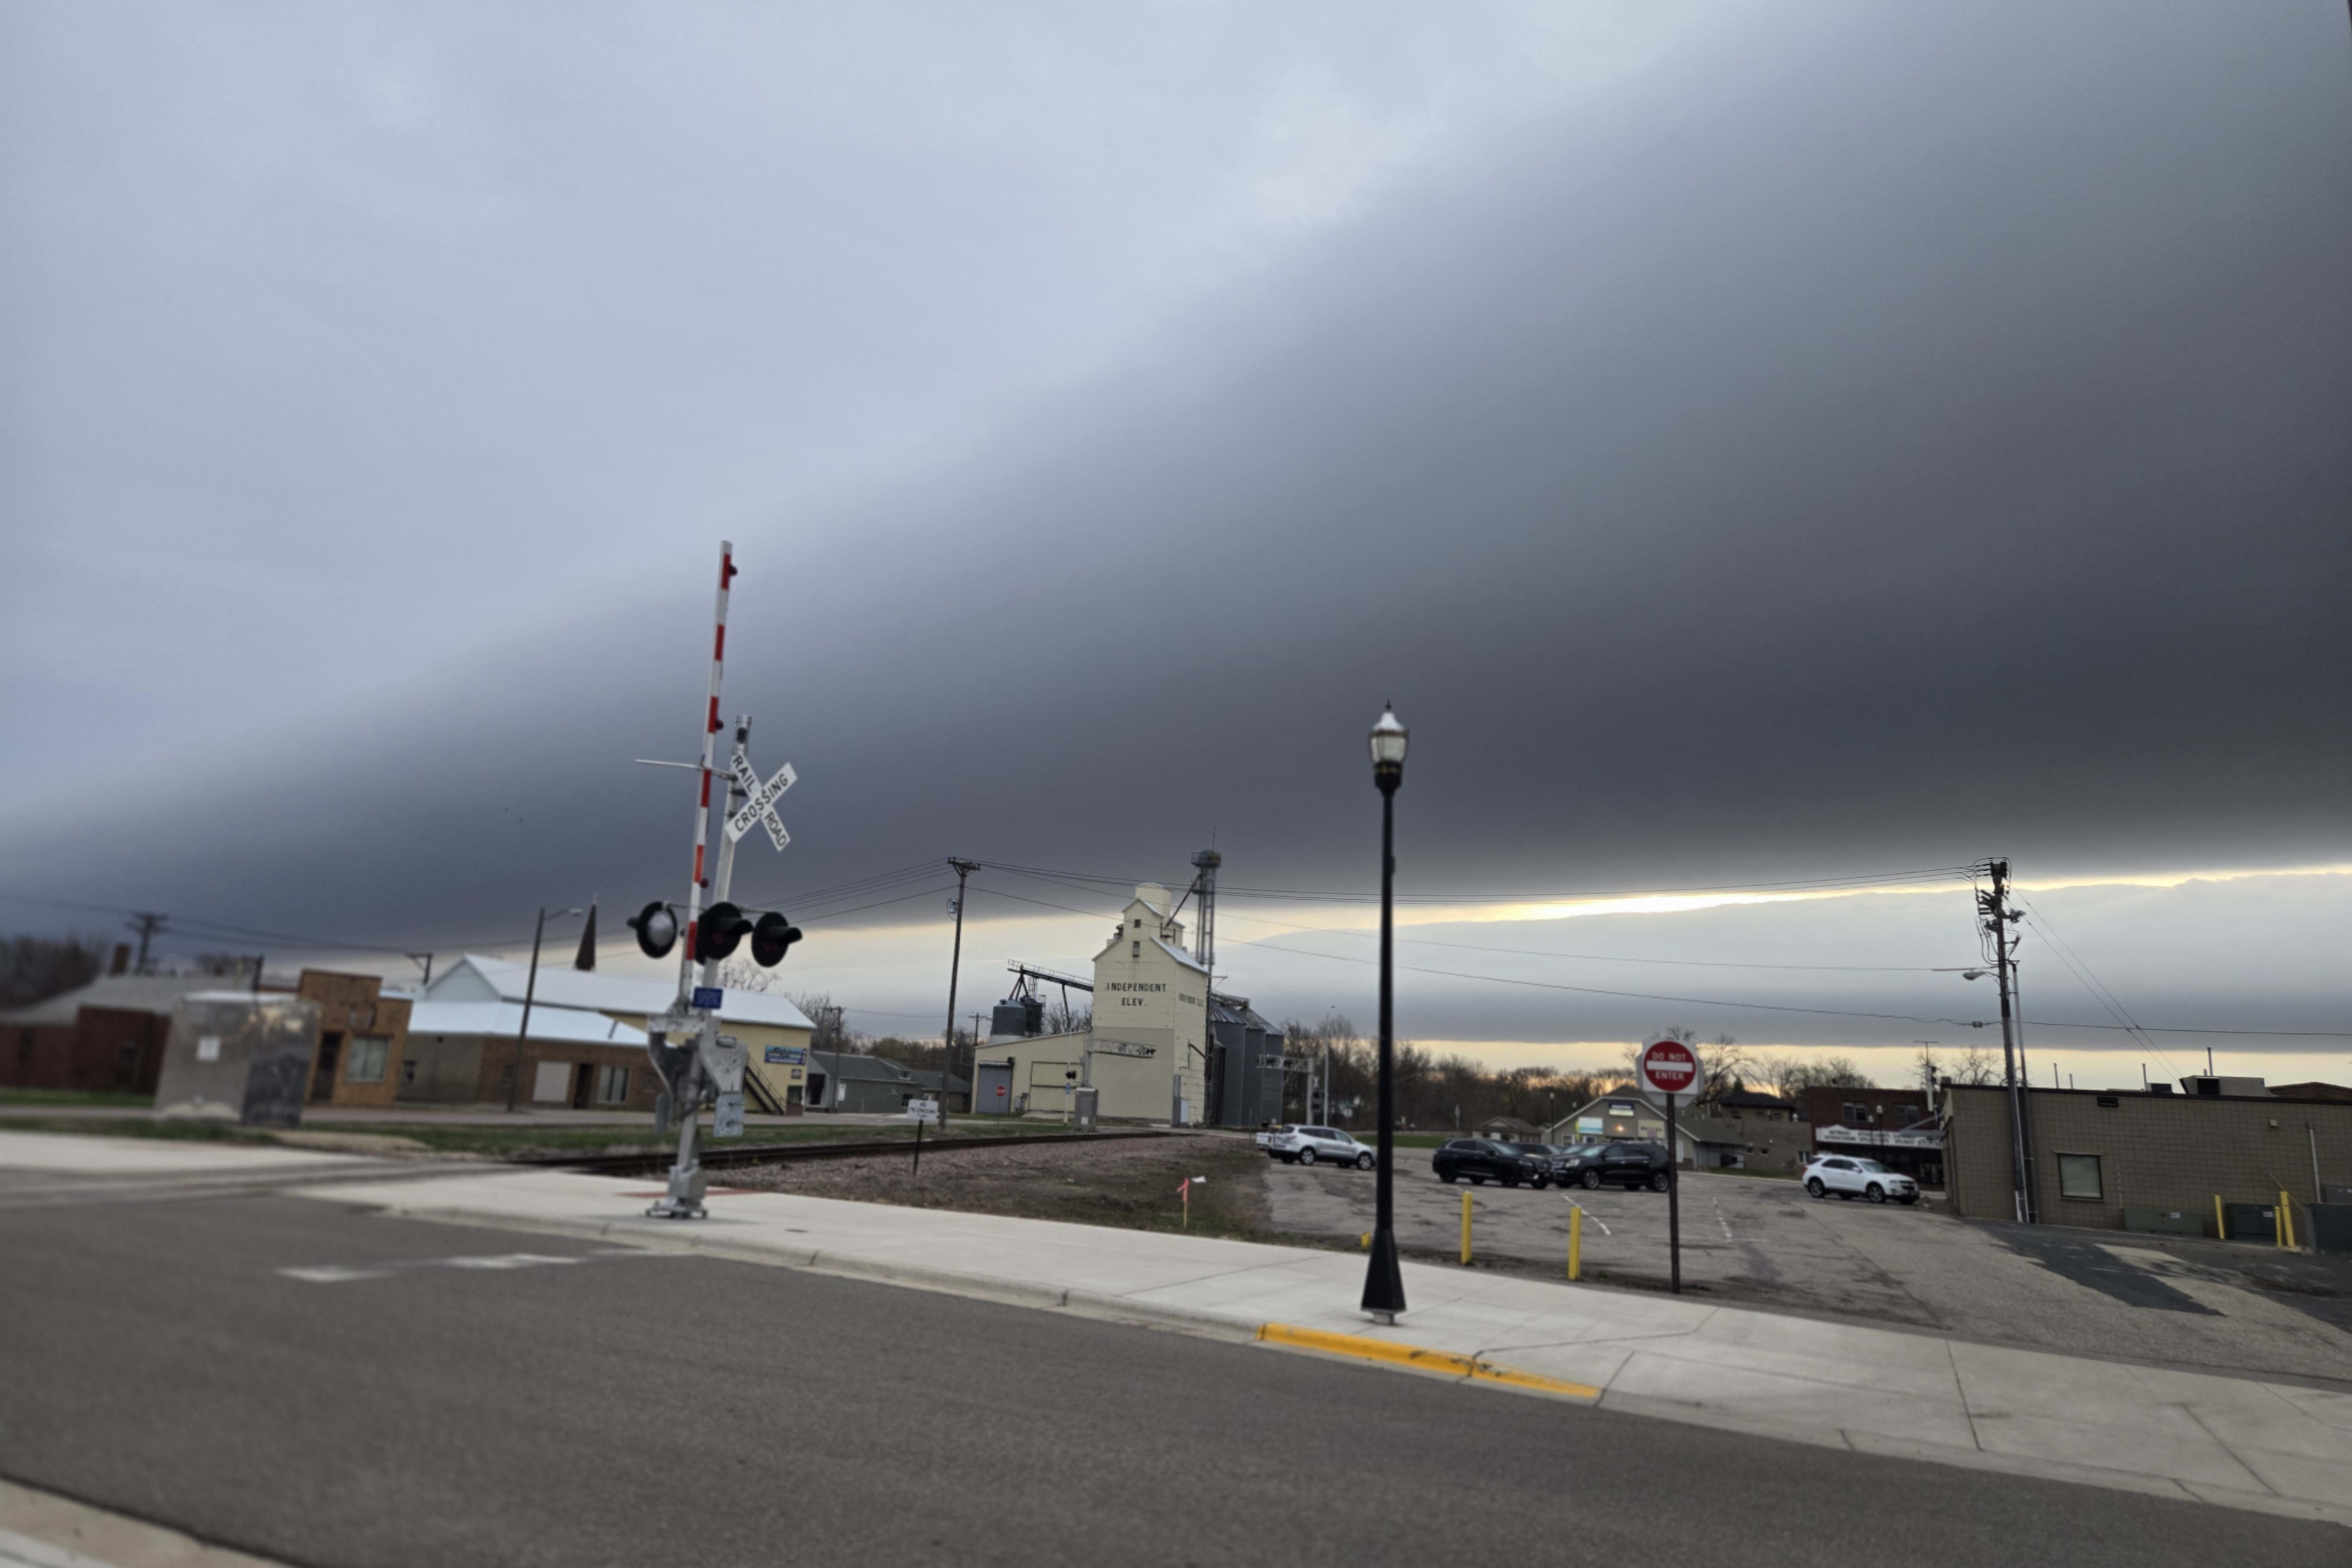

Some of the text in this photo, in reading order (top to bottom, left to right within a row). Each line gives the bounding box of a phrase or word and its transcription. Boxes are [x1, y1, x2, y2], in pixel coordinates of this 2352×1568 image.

[733, 755, 755, 793] RAIL
[735, 773, 788, 832] CROSSING
[765, 811, 786, 846] ROAD
[1106, 982, 1166, 992] INDEPENDENT
[1121, 997, 1147, 1006] ELEV.
[1652, 1052, 1686, 1061] DO NOT
[1656, 1071, 1684, 1080] ENTER
